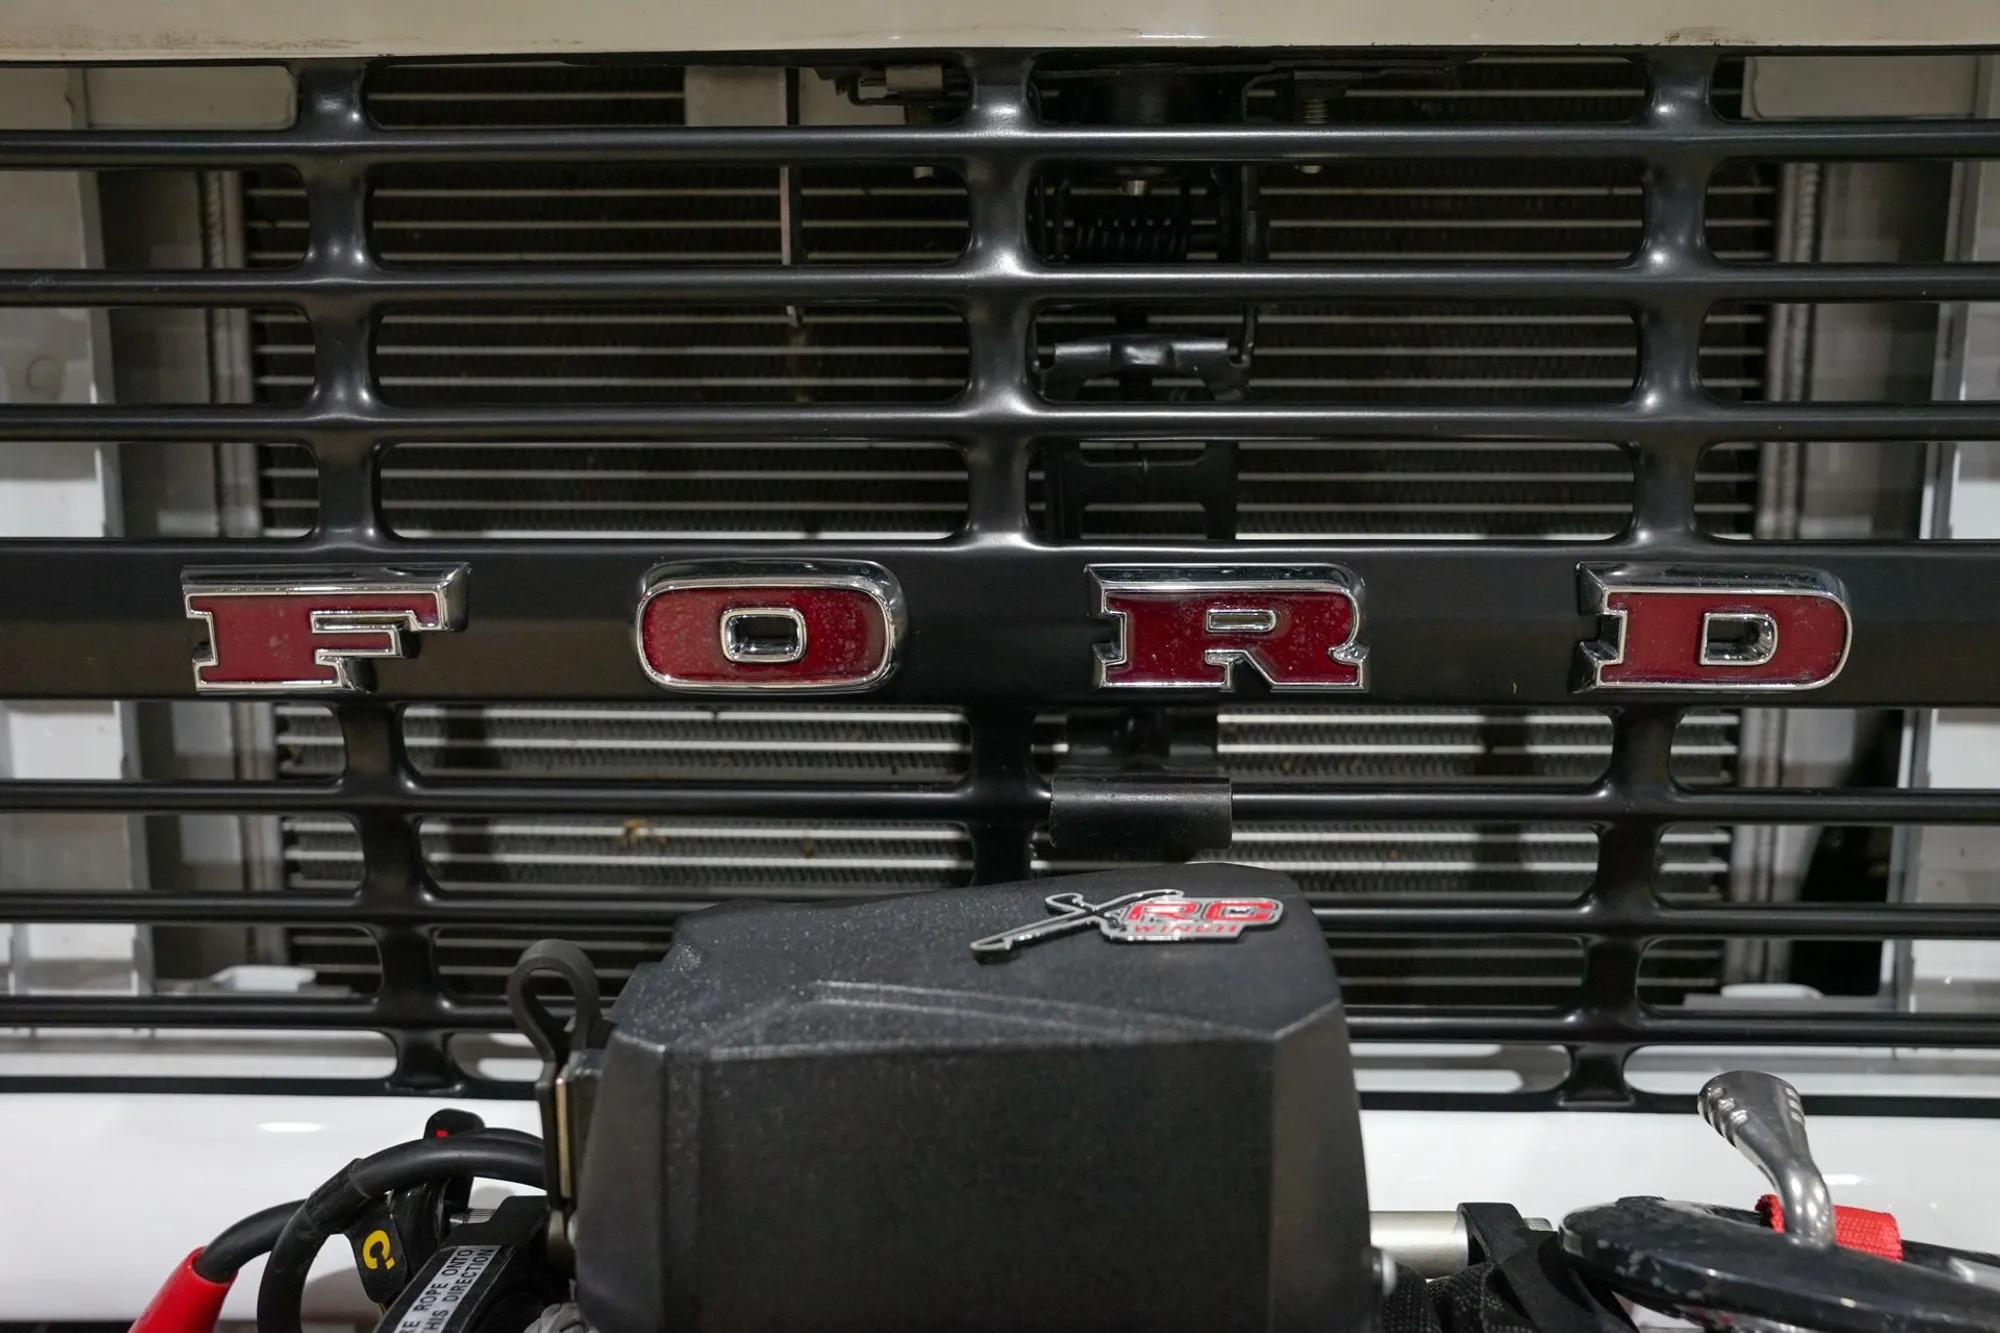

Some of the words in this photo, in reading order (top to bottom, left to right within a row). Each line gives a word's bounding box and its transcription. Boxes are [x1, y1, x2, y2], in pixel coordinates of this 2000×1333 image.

[181, 560, 1852, 696] FORD
[413, 1283, 449, 1312] ROPE
[442, 1249, 473, 1276] ONTO
[442, 1248, 495, 1302] DIRECTION
